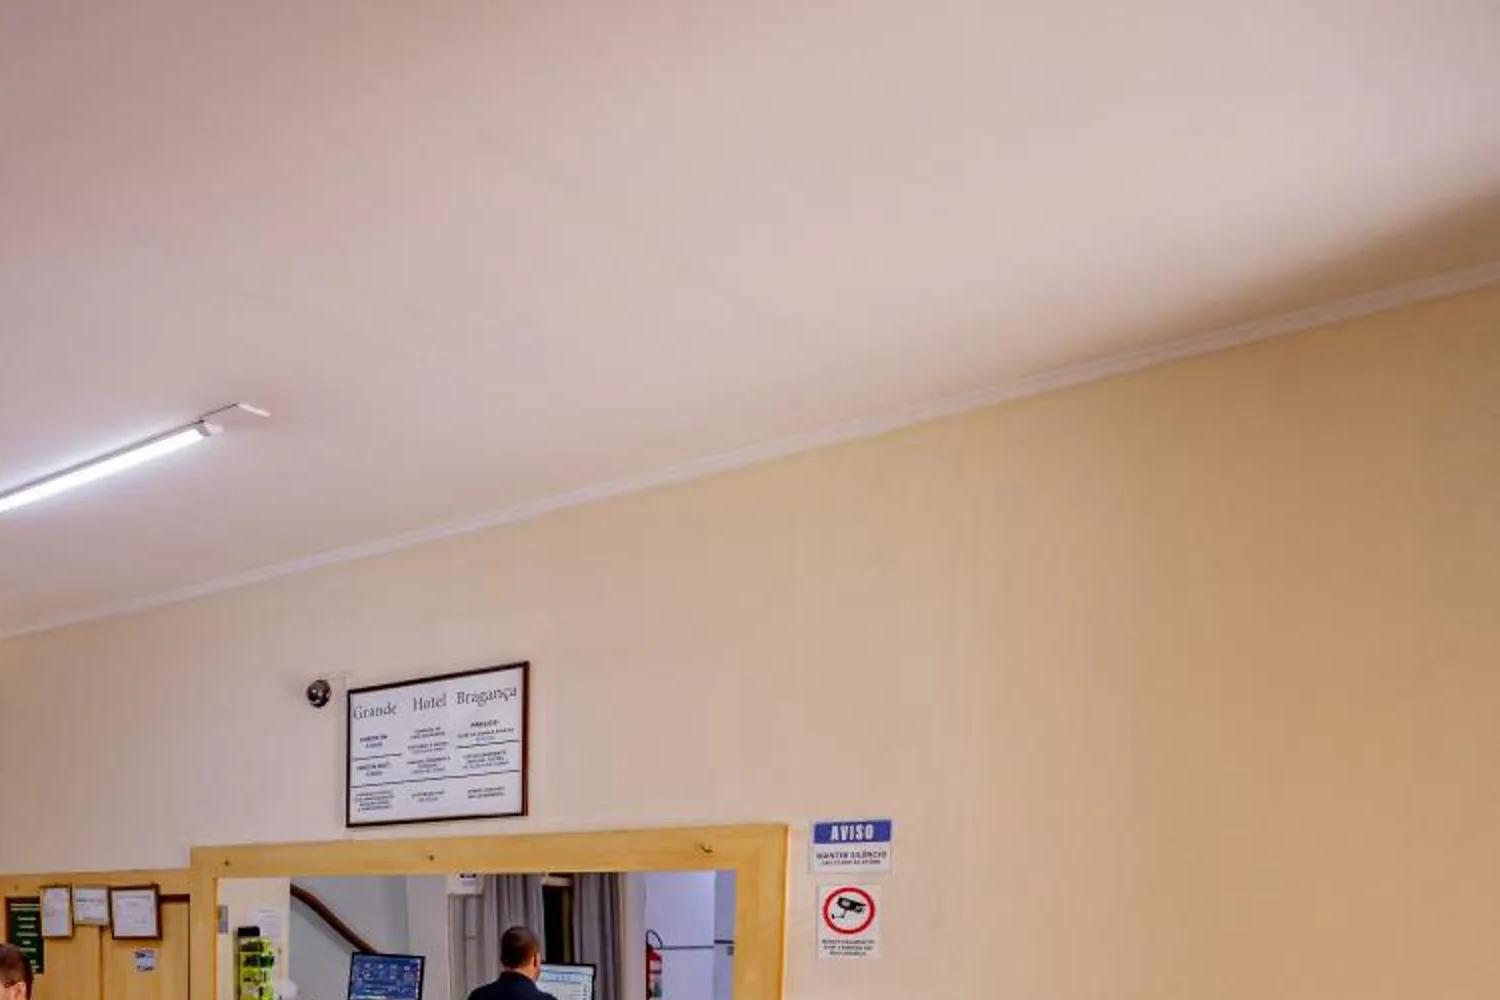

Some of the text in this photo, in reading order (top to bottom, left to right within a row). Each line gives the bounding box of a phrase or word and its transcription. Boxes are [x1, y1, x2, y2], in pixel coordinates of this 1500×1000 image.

[353, 686, 518, 720] Grande Hotel Bragança
[830, 824, 875, 841] AVISO
